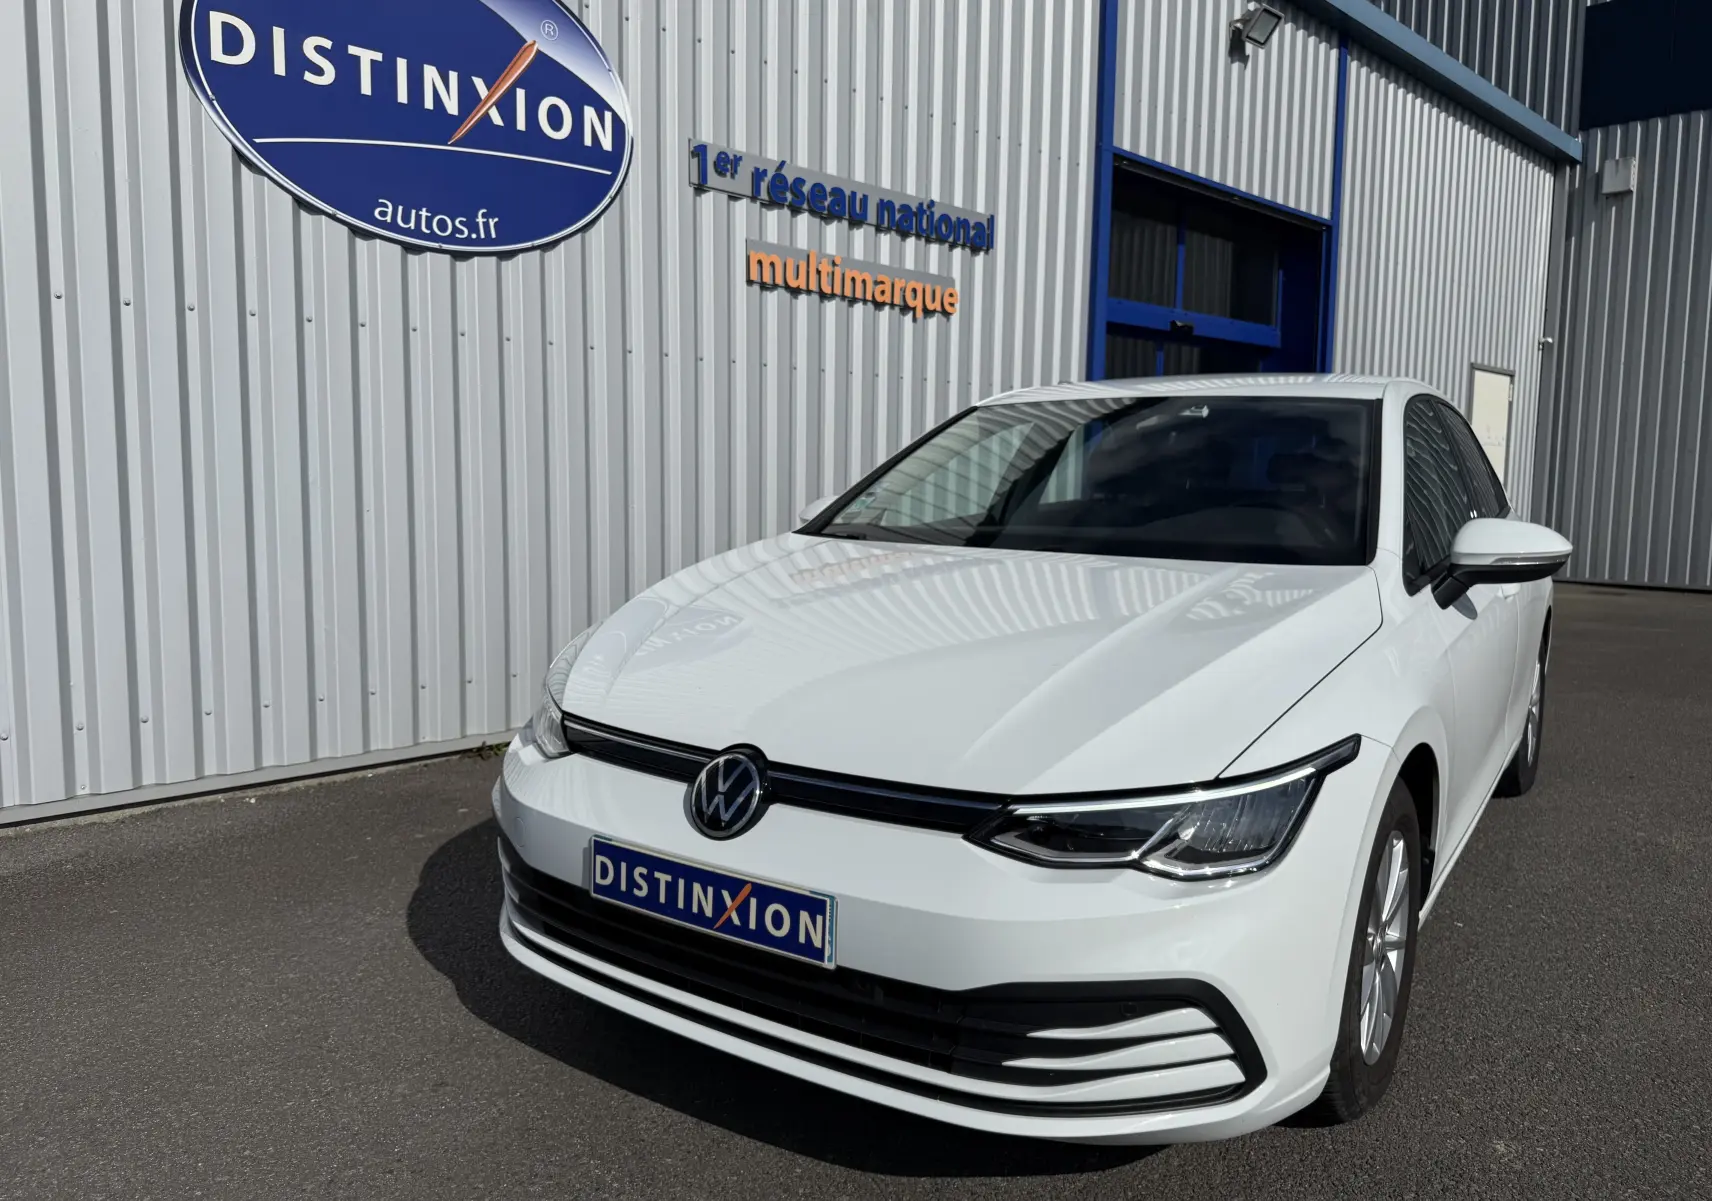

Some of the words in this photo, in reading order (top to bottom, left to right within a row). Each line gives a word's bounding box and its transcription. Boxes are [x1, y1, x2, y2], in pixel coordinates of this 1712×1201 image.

[208, 10, 614, 152] DISTINXION
[373, 199, 499, 240] autos.fr
[692, 143, 743, 186] 1er
[751, 160, 869, 222] réseau
[877, 198, 995, 250] national
[748, 249, 959, 319] multimarque
[594, 854, 824, 949] DISTINXION
